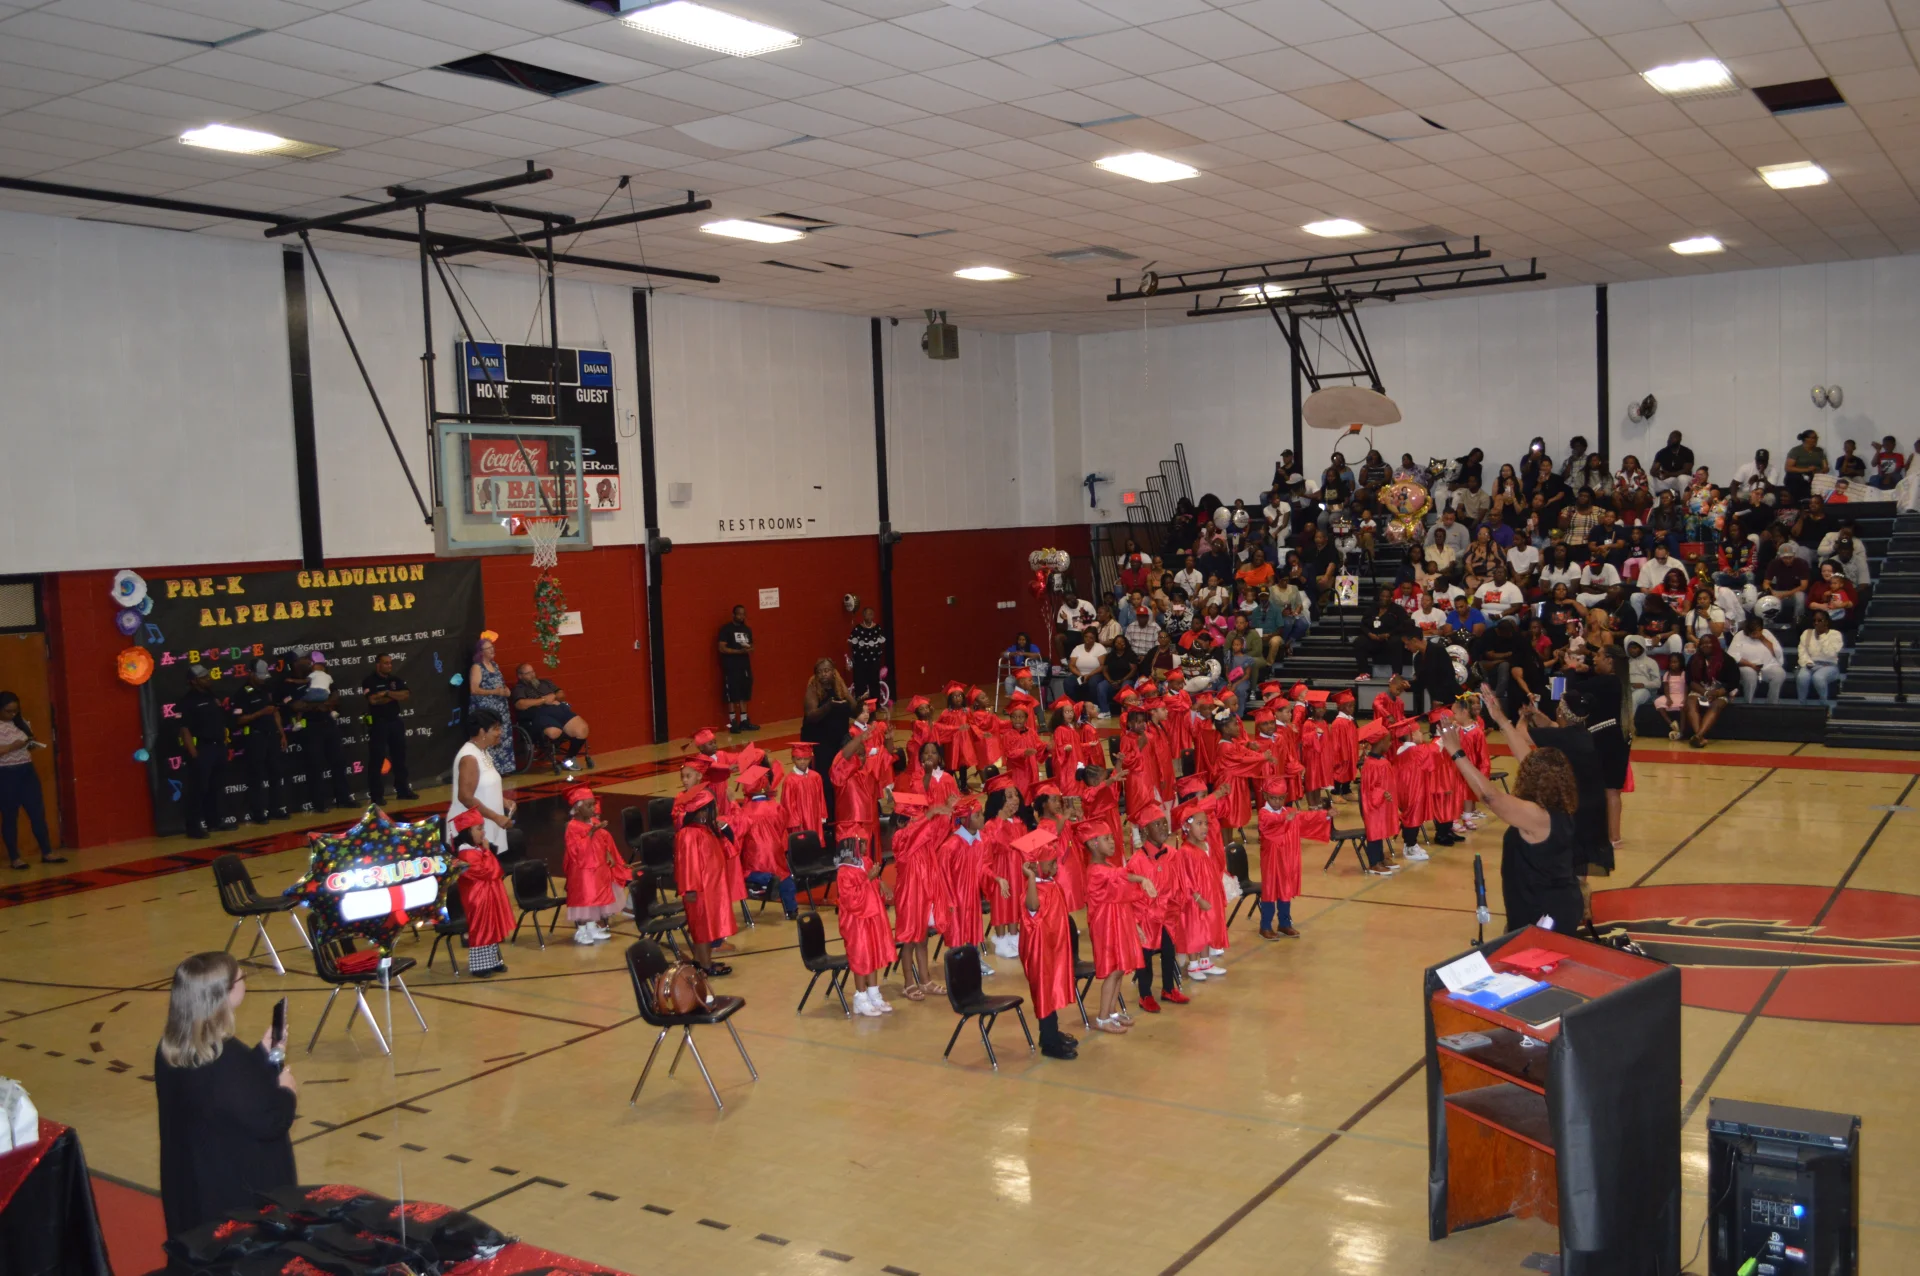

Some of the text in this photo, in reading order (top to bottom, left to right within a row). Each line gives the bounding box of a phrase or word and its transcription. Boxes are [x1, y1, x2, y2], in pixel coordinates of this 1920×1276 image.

[583, 363, 608, 374] DASANI
[576, 388, 608, 404] GUEST
[480, 447, 542, 474] Coca-Cola
[718, 517, 803, 532] RESTROOMS
[165, 564, 424, 598] PRE-K GRADUATION
[200, 592, 415, 626] ALPHABET RAP
[340, 639, 357, 648] WILL
[362, 637, 371, 646] BE
[374, 635, 387, 644] THE
[391, 633, 412, 642] PLACE
[415, 631, 429, 640] FOR
[341, 656, 361, 665] BEST
[326, 855, 448, 891] CONGRATULATIONS
